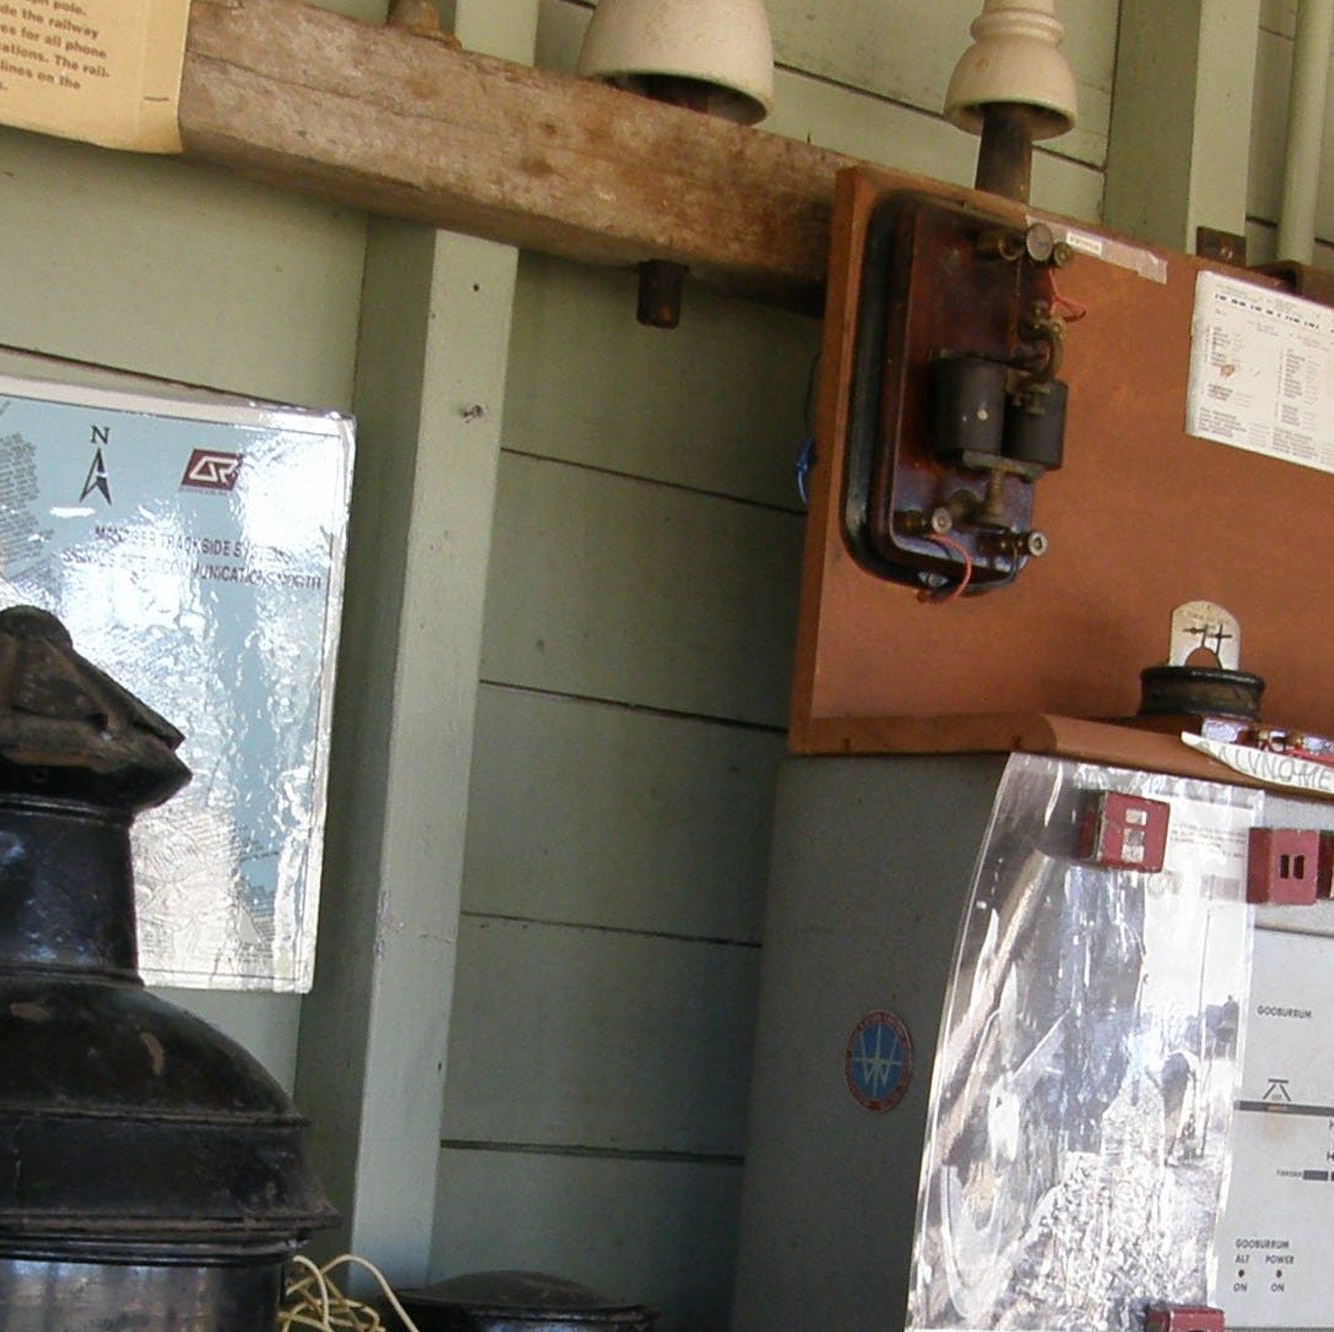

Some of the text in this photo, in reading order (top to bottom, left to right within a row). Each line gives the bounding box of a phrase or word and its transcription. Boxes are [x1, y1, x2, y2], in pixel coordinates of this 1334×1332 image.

[21, 7, 45, 24] the
[48, 15, 99, 39] railway
[20, 26, 40, 42] for
[44, 34, 62, 48] all
[65, 38, 107, 59] phone
[0, 57, 34, 78] lines
[37, 71, 56, 84] on
[58, 72, 81, 91] the
[54, 54, 80, 71] The
[82, 61, 110, 78] rail-
[90, 425, 111, 445] N
[1265, 1254, 1295, 1265] POWER
[1233, 1282, 1285, 1293] ON ON
